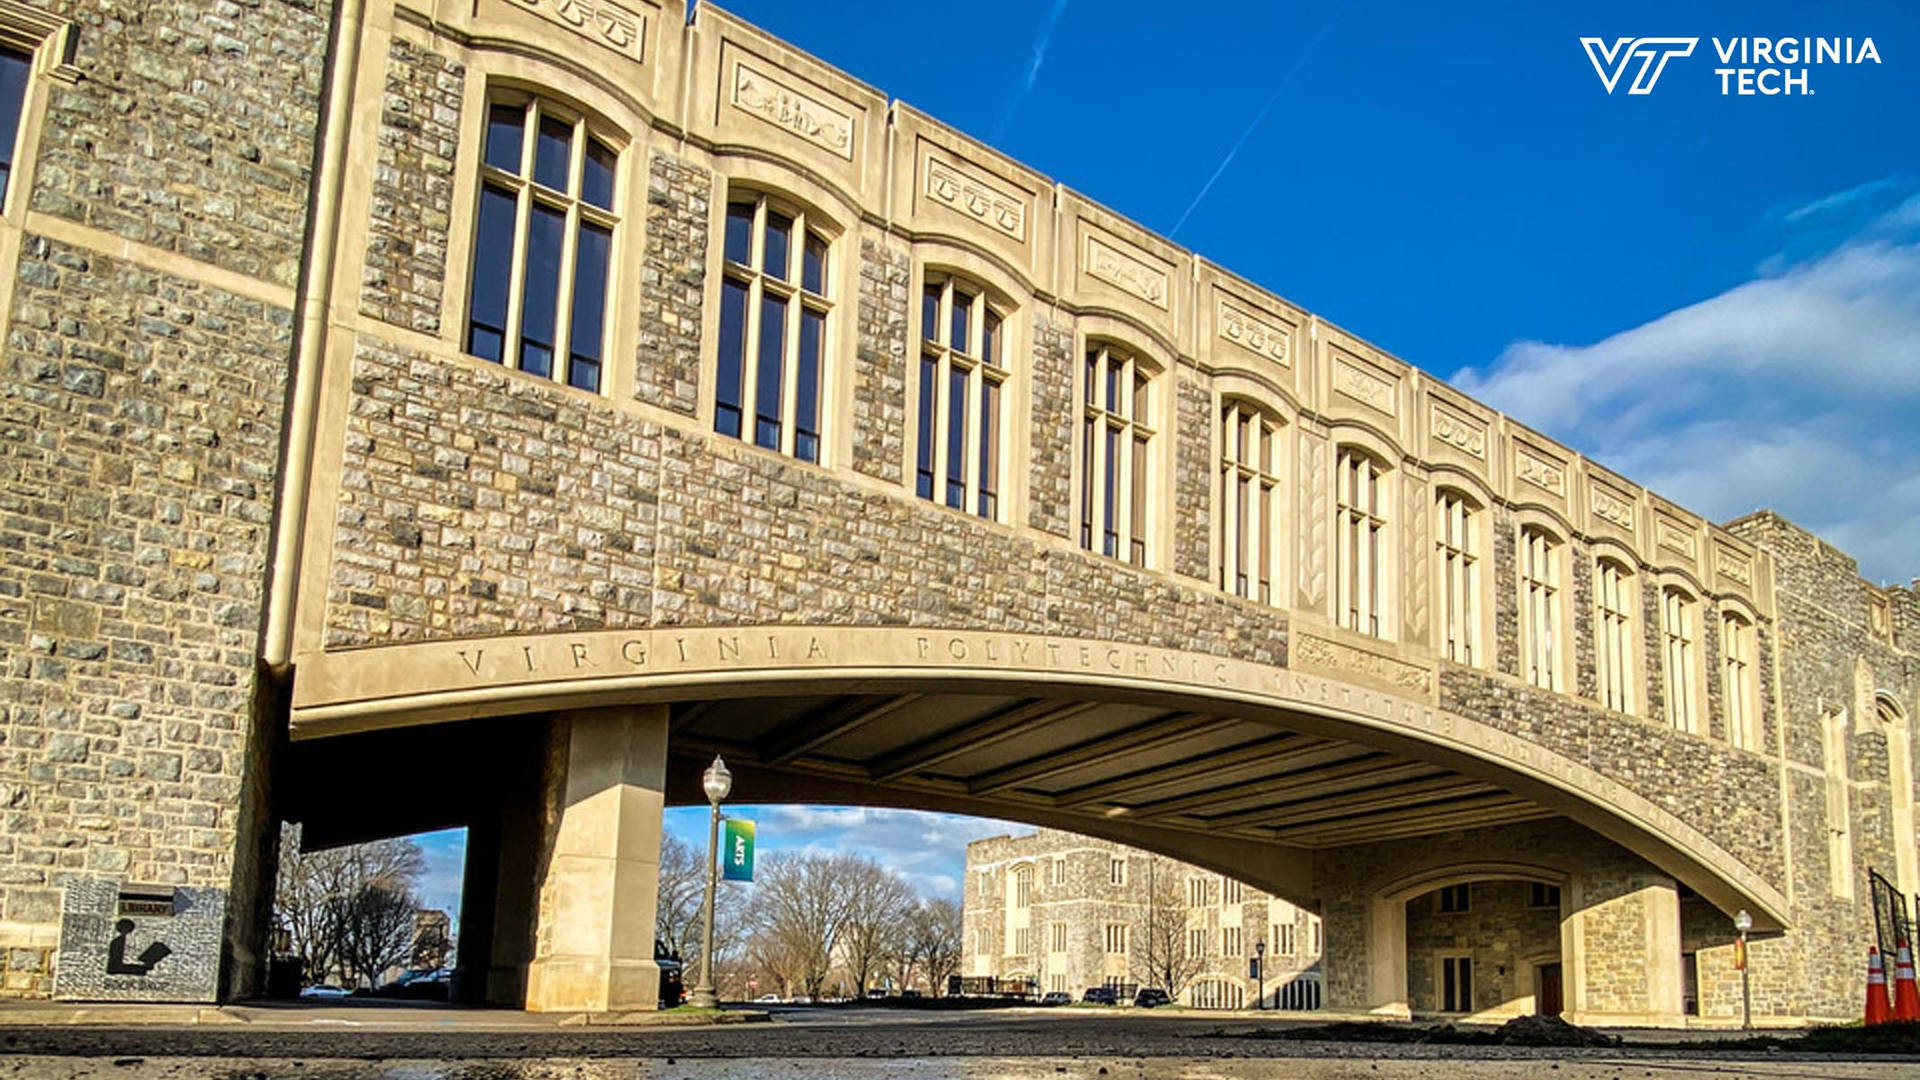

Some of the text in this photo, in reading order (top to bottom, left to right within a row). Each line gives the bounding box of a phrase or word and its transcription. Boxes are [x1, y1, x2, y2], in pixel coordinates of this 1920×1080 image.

[458, 635, 1453, 736] VIRGINIA POLYTECHNIC INSTITUTE
[735, 835, 746, 866] ARTS
[122, 903, 168, 914] LIBRARY
